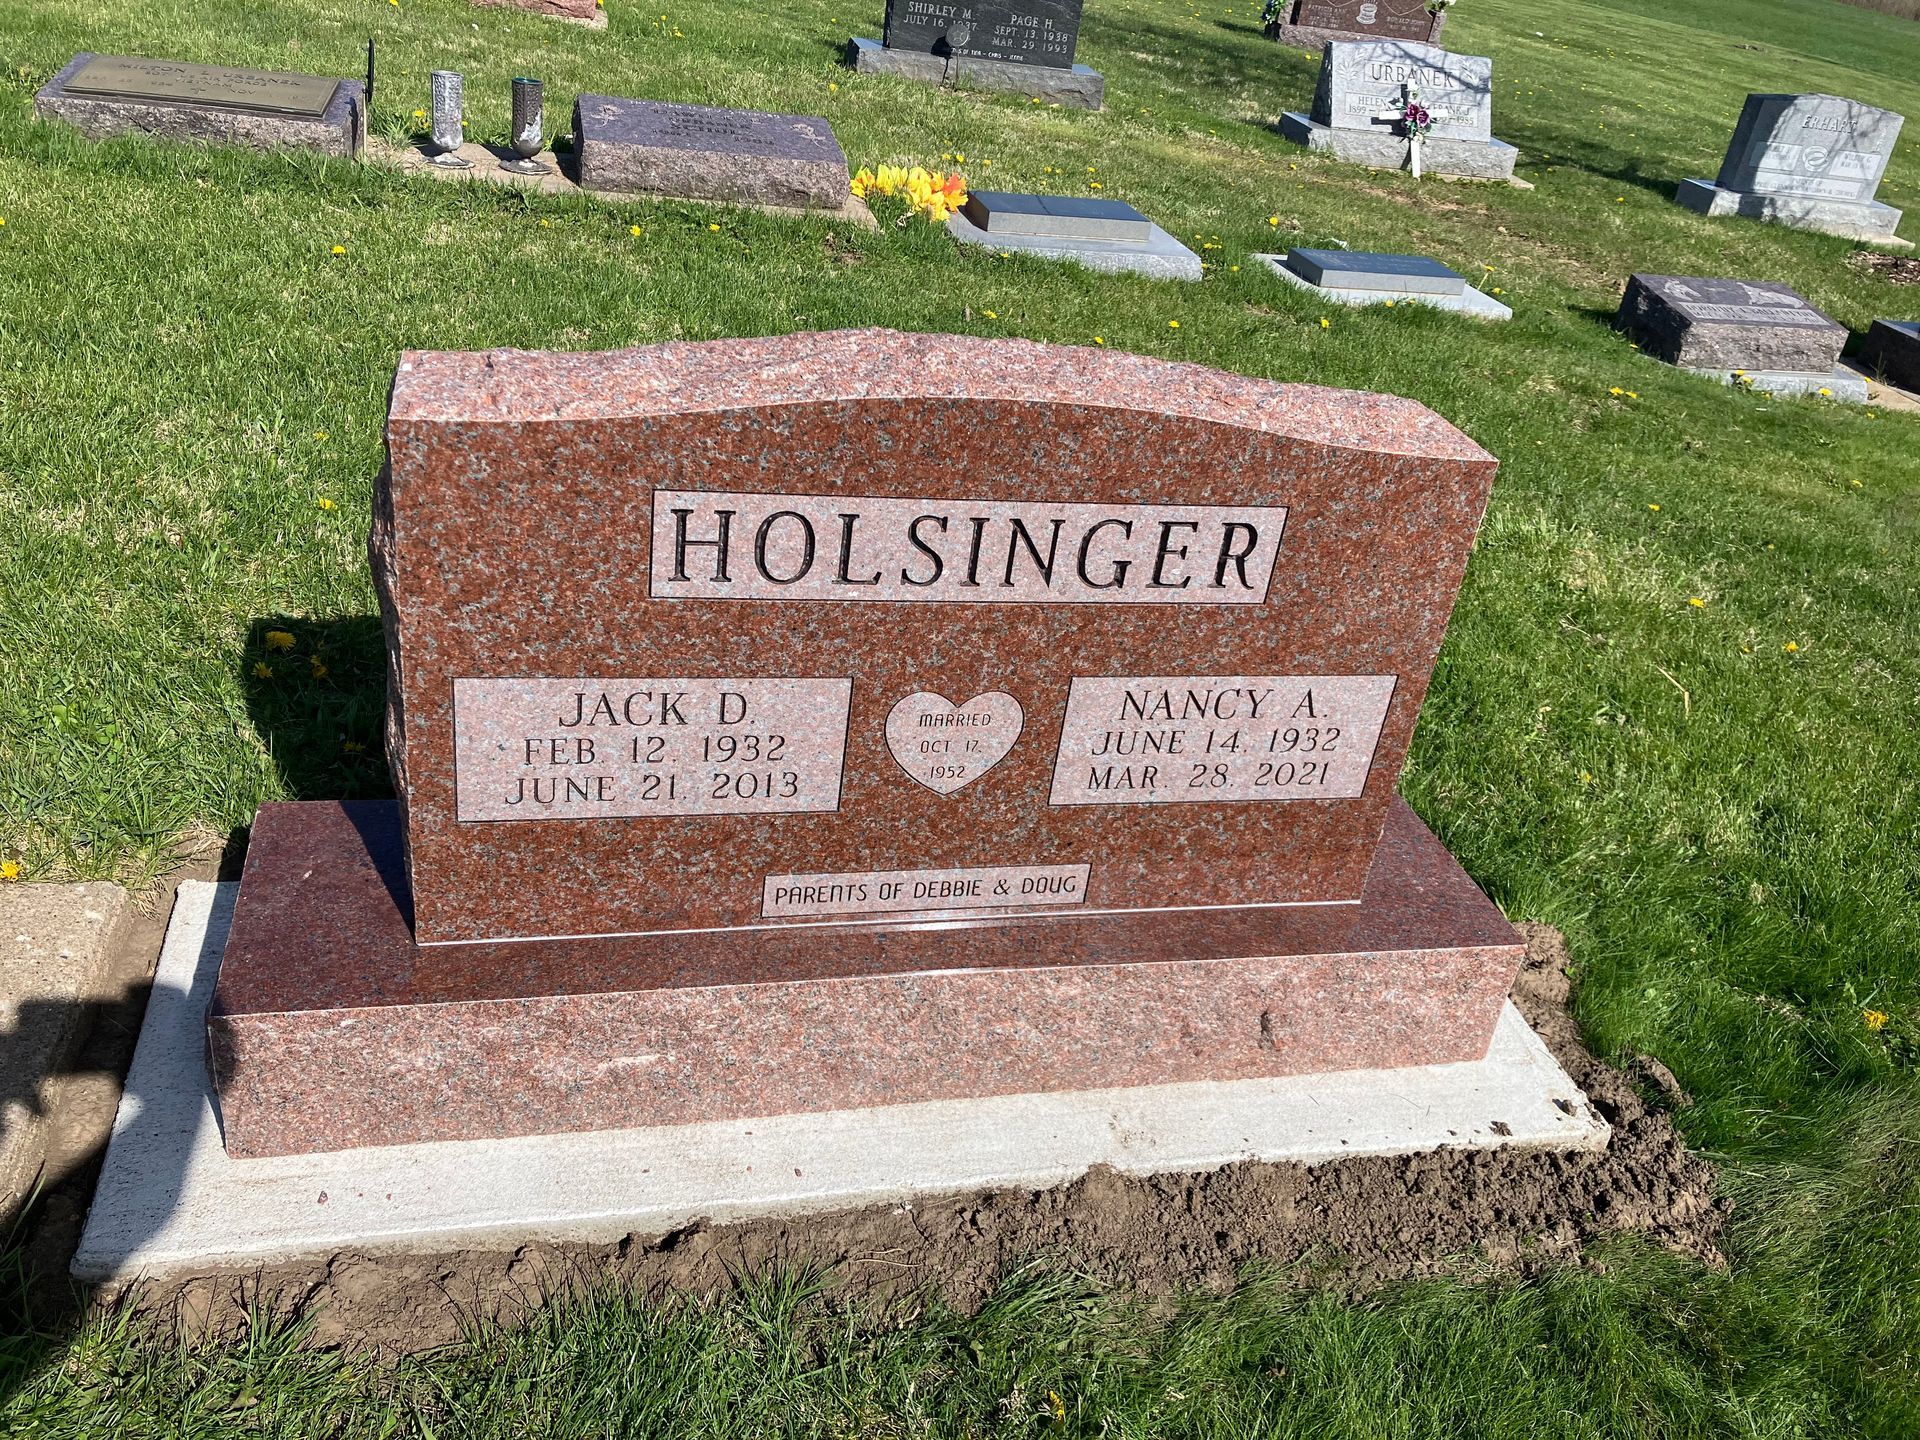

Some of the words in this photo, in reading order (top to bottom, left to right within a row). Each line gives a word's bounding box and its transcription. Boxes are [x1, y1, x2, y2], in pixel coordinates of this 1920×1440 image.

[903, 14, 929, 26] JULY
[908, 1, 957, 17] SHIRLEY
[962, 8, 976, 20] M.
[1010, 14, 1039, 28] PAGE
[1044, 18, 1056, 31] H.
[994, 25, 1020, 37] SEPT.
[1043, 31, 1068, 43] 1938
[991, 37, 1017, 49] MAR.
[1042, 42, 1068, 54] 1993
[119, 63, 187, 74] MILTON
[1371, 63, 1454, 88] URBANEK
[1349, 105, 1367, 114] 1899
[1358, 95, 1389, 110] HELEN
[1801, 114, 1858, 134] ERHART
[667, 507, 1259, 590] HOLSINGER
[558, 691, 689, 728] JACK
[717, 692, 756, 726] D.
[1118, 688, 1274, 721] NANCY
[1290, 687, 1329, 719] A.
[919, 713, 991, 727] MARRIED
[523, 737, 606, 766] FEB.
[703, 733, 787, 763] 1932
[920, 740, 951, 753] OCT
[1091, 730, 1185, 756] JUNE
[1267, 727, 1341, 753] 1932
[930, 765, 966, 779] 1952
[1087, 765, 1169, 791] MAR.
[1254, 760, 1330, 787] 2021
[504, 776, 617, 806] JUNE
[711, 771, 799, 800] 2013
[775, 883, 868, 906] PARENTS
[878, 881, 904, 901] OF
[913, 878, 984, 899] DEBBIE
[993, 878, 1011, 896] &
[1021, 874, 1077, 895] DOUG
